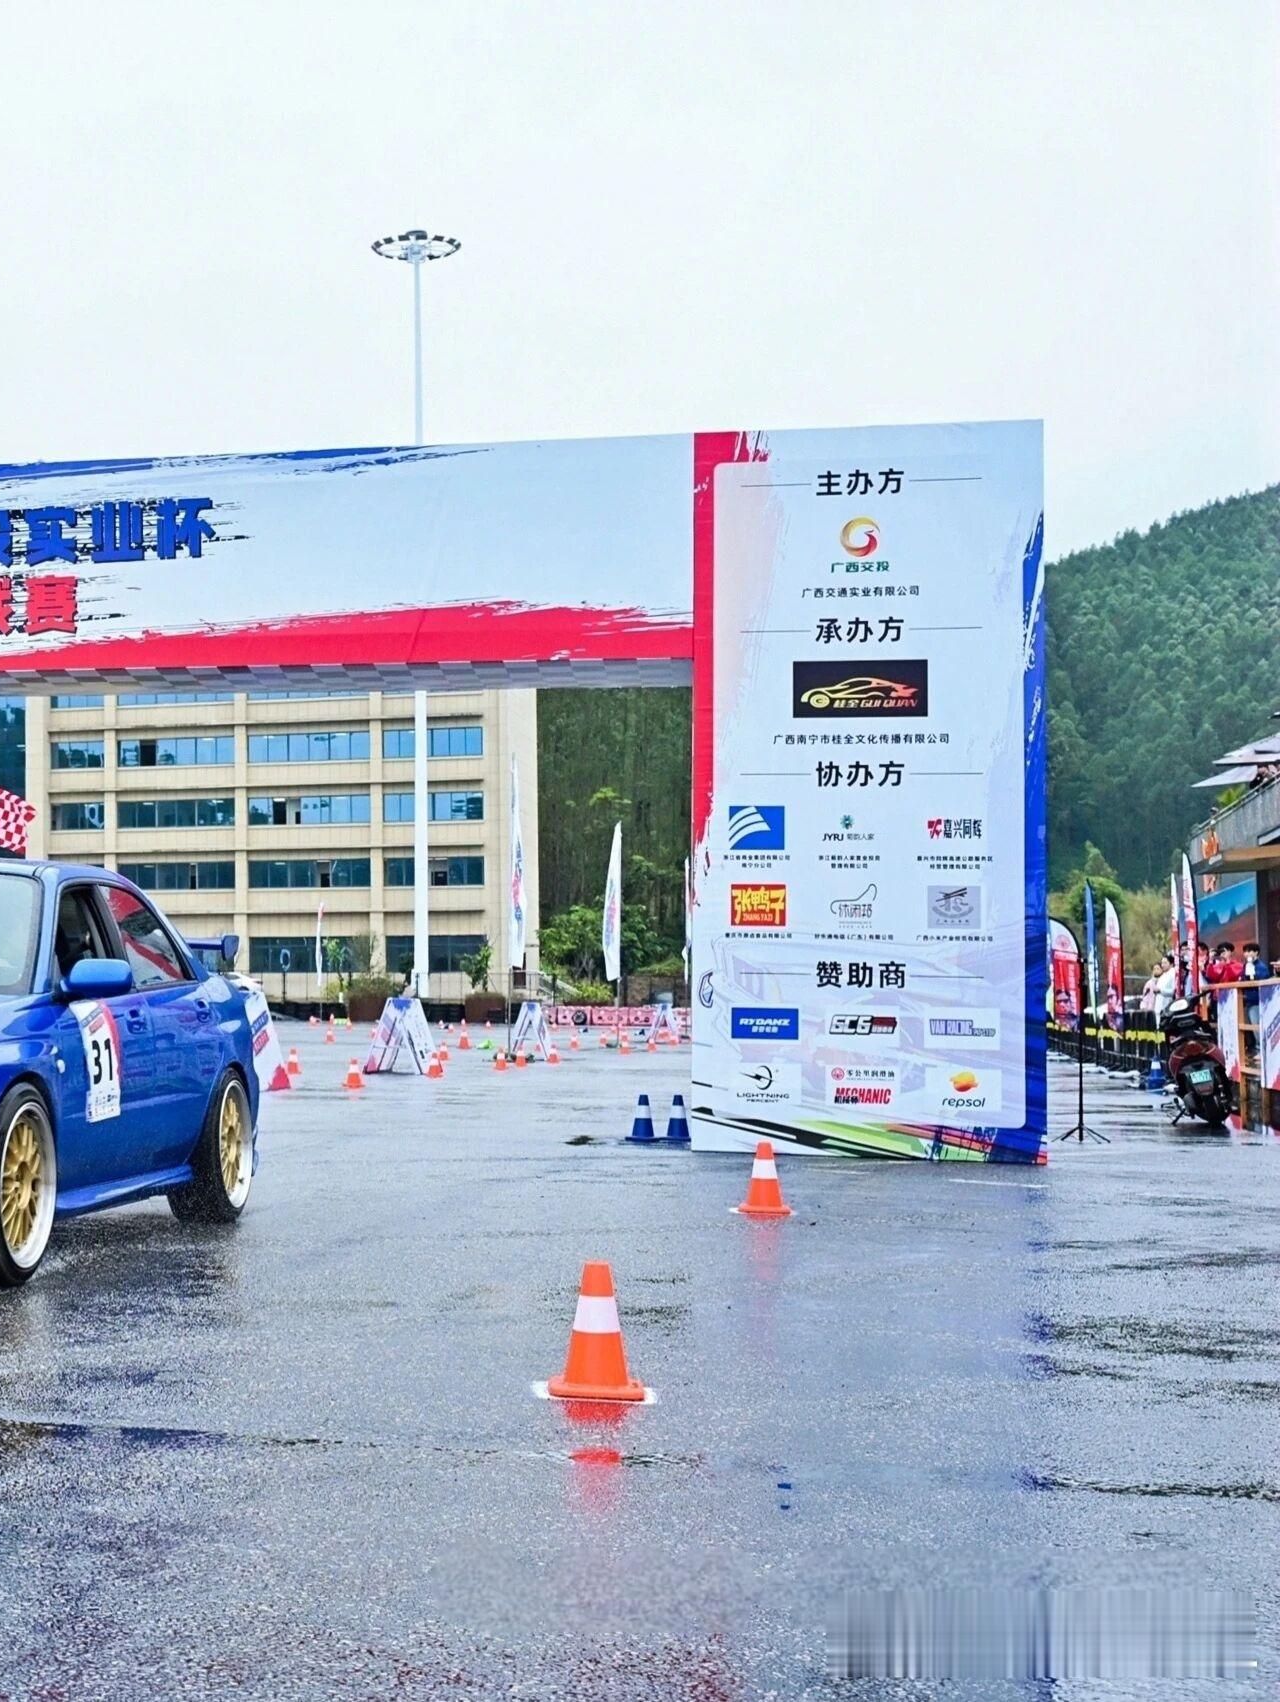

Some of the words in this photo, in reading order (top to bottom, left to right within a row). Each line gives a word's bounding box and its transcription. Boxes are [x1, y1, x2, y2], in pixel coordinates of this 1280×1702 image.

[816, 468, 905, 496] 主办方
[831, 561, 890, 573] 广西交投
[801, 585, 920, 598] 广西交通实业有限公司
[815, 616, 904, 644] 承办方
[773, 732, 950, 745] 广西南宁市桂全文化传播有限公司
[815, 761, 905, 788] 协办方
[943, 818, 982, 839] 嘉兴同辉
[731, 886, 786, 926] 张鸭子
[815, 961, 906, 989] 赞助商
[91, 1038, 113, 1085] 31
[942, 1097, 986, 1108] repsol
